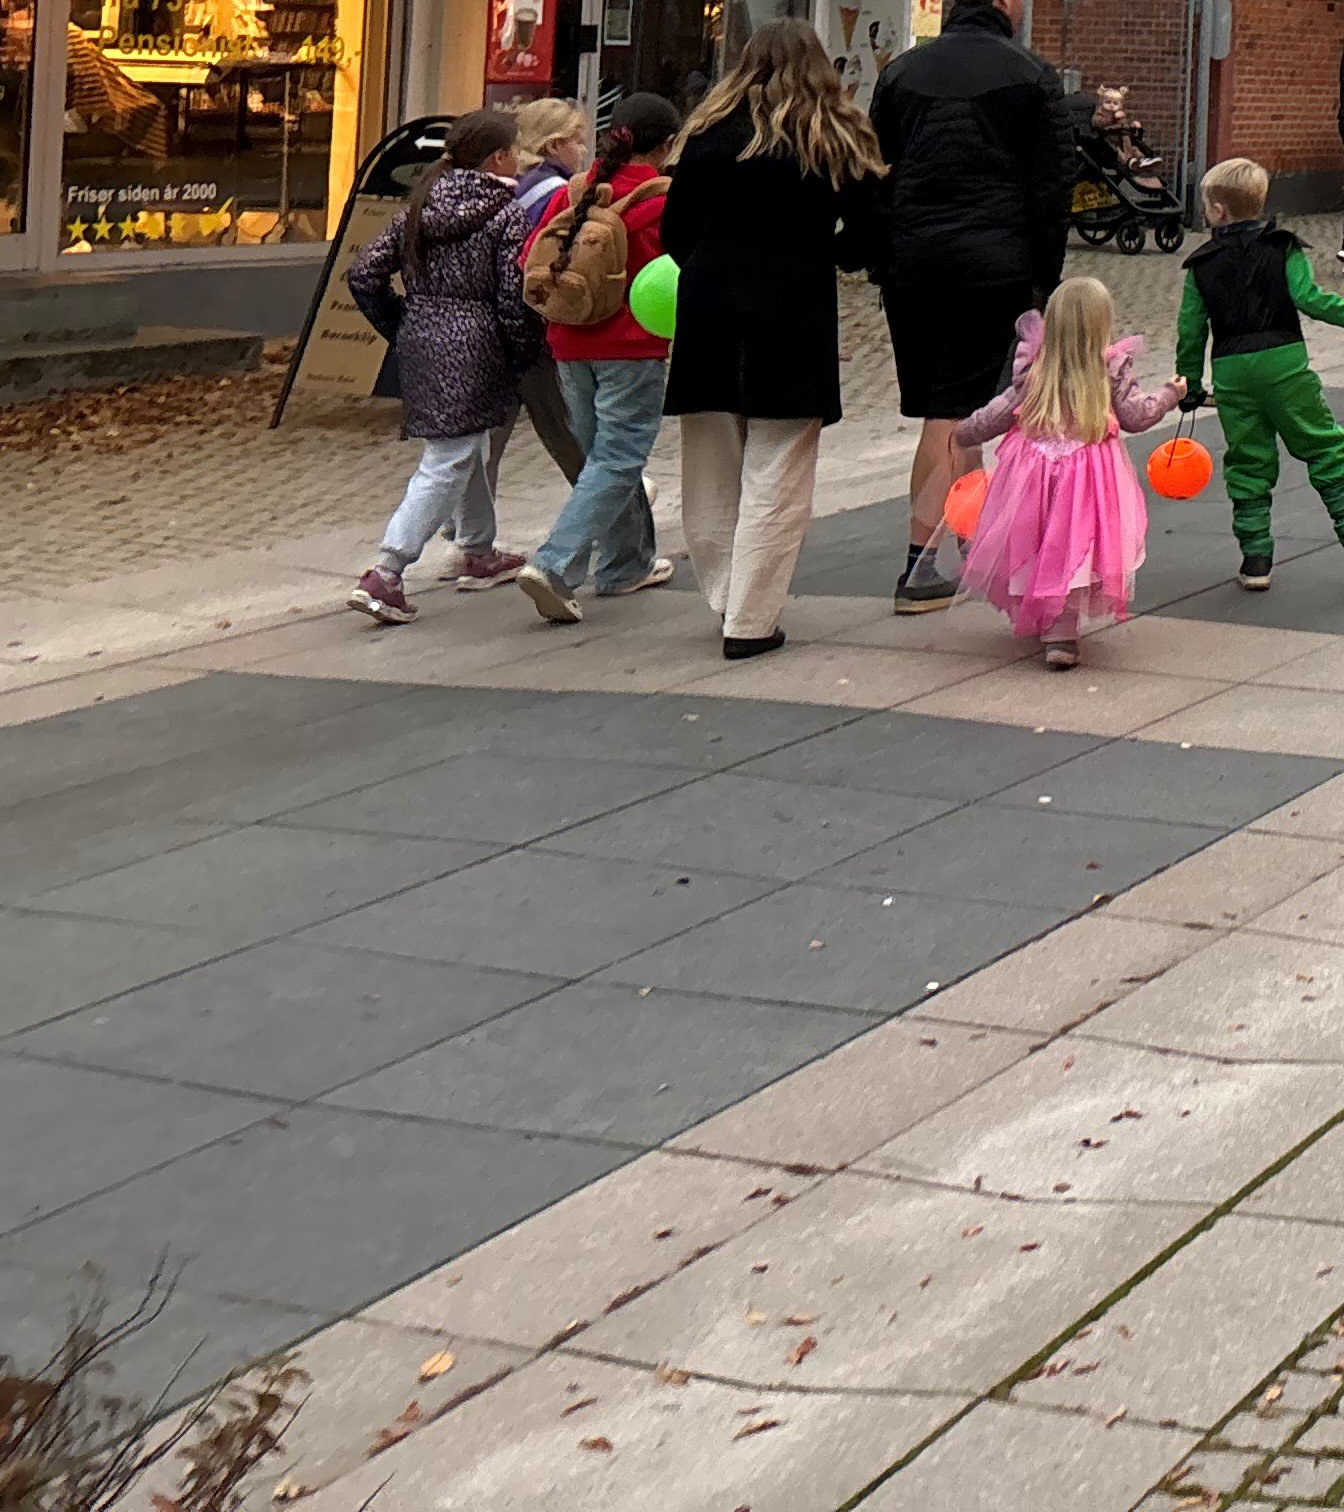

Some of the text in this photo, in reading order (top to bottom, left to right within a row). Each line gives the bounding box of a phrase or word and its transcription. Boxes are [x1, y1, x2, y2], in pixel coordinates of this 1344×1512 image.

[67, 182, 217, 205] Frisør siden år 2000
